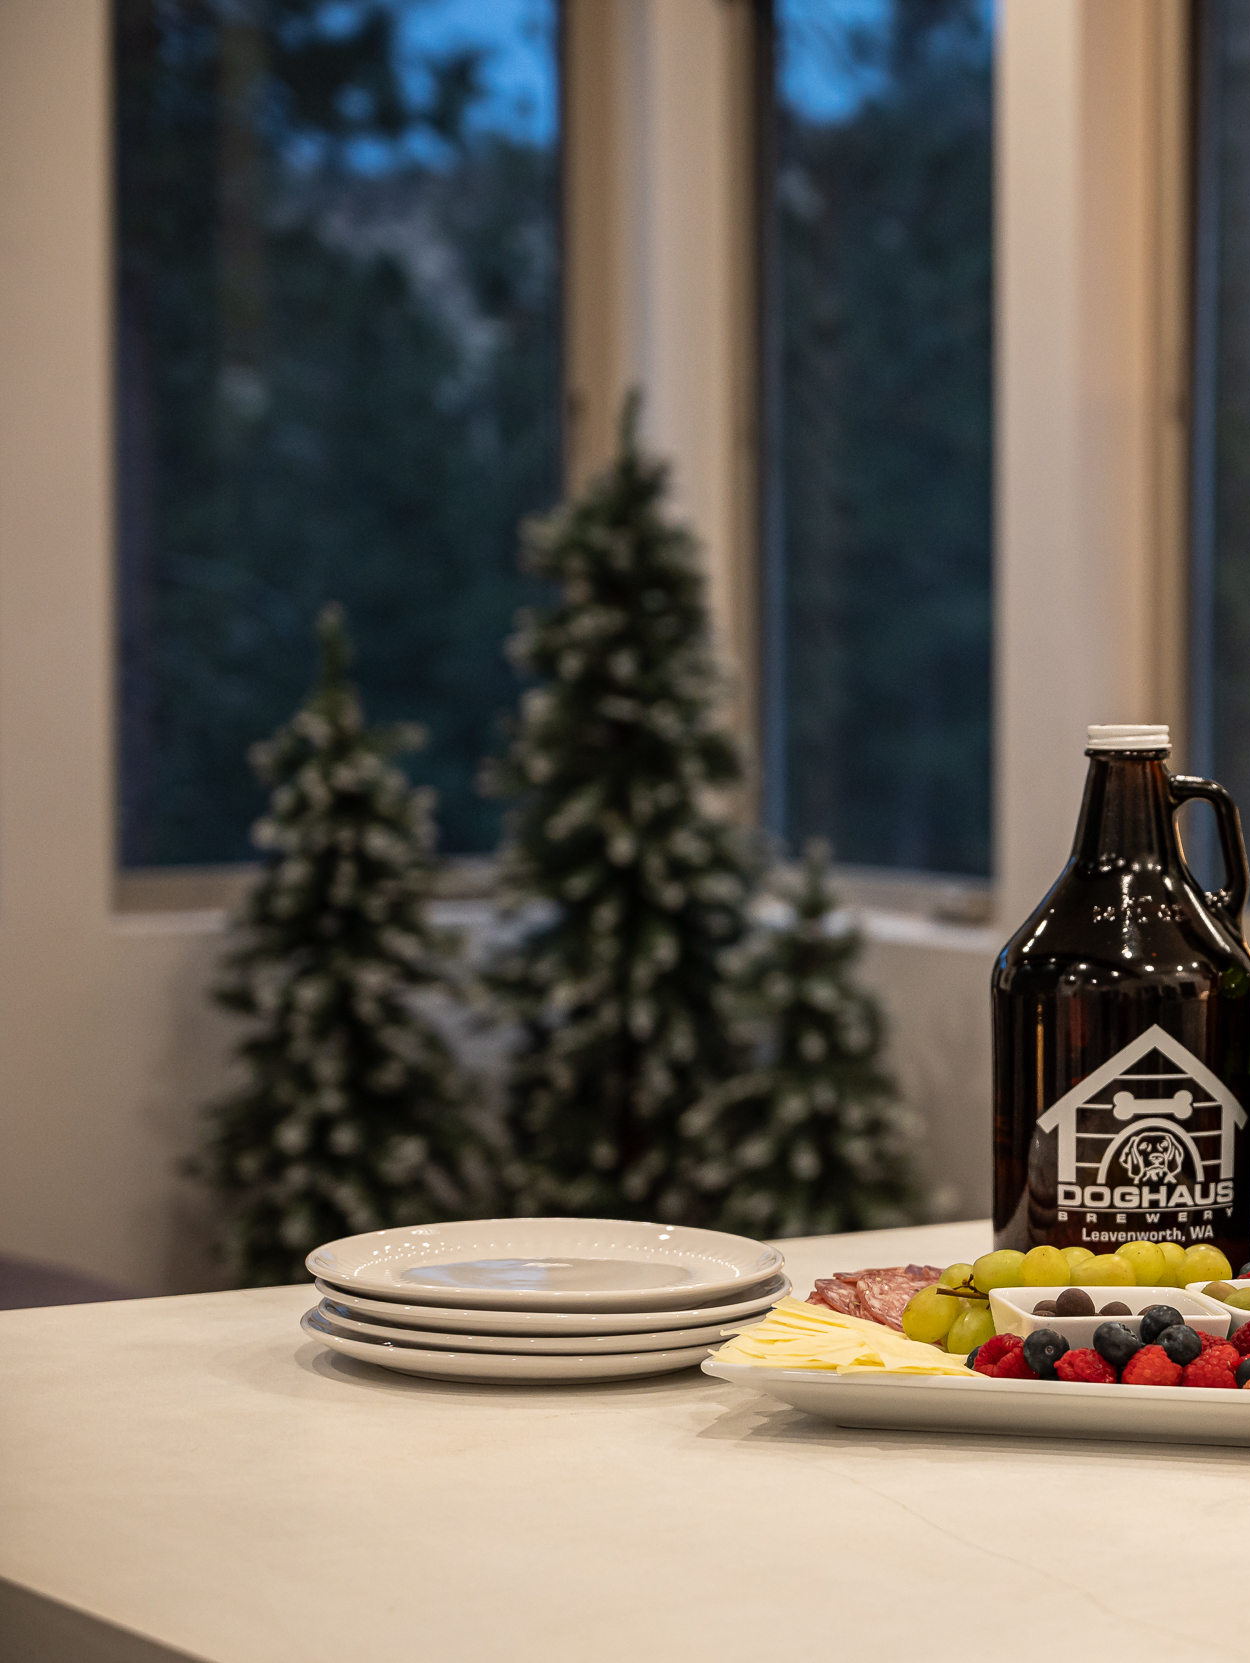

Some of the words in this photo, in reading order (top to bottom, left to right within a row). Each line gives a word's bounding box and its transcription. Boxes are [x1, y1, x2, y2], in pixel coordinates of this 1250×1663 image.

[1057, 1181, 1234, 1208] DOGHAUS
[1057, 1208, 1233, 1224] BREWERY
[1082, 1227, 1186, 1243] Leavenworth,
[1190, 1224, 1214, 1239] WA
